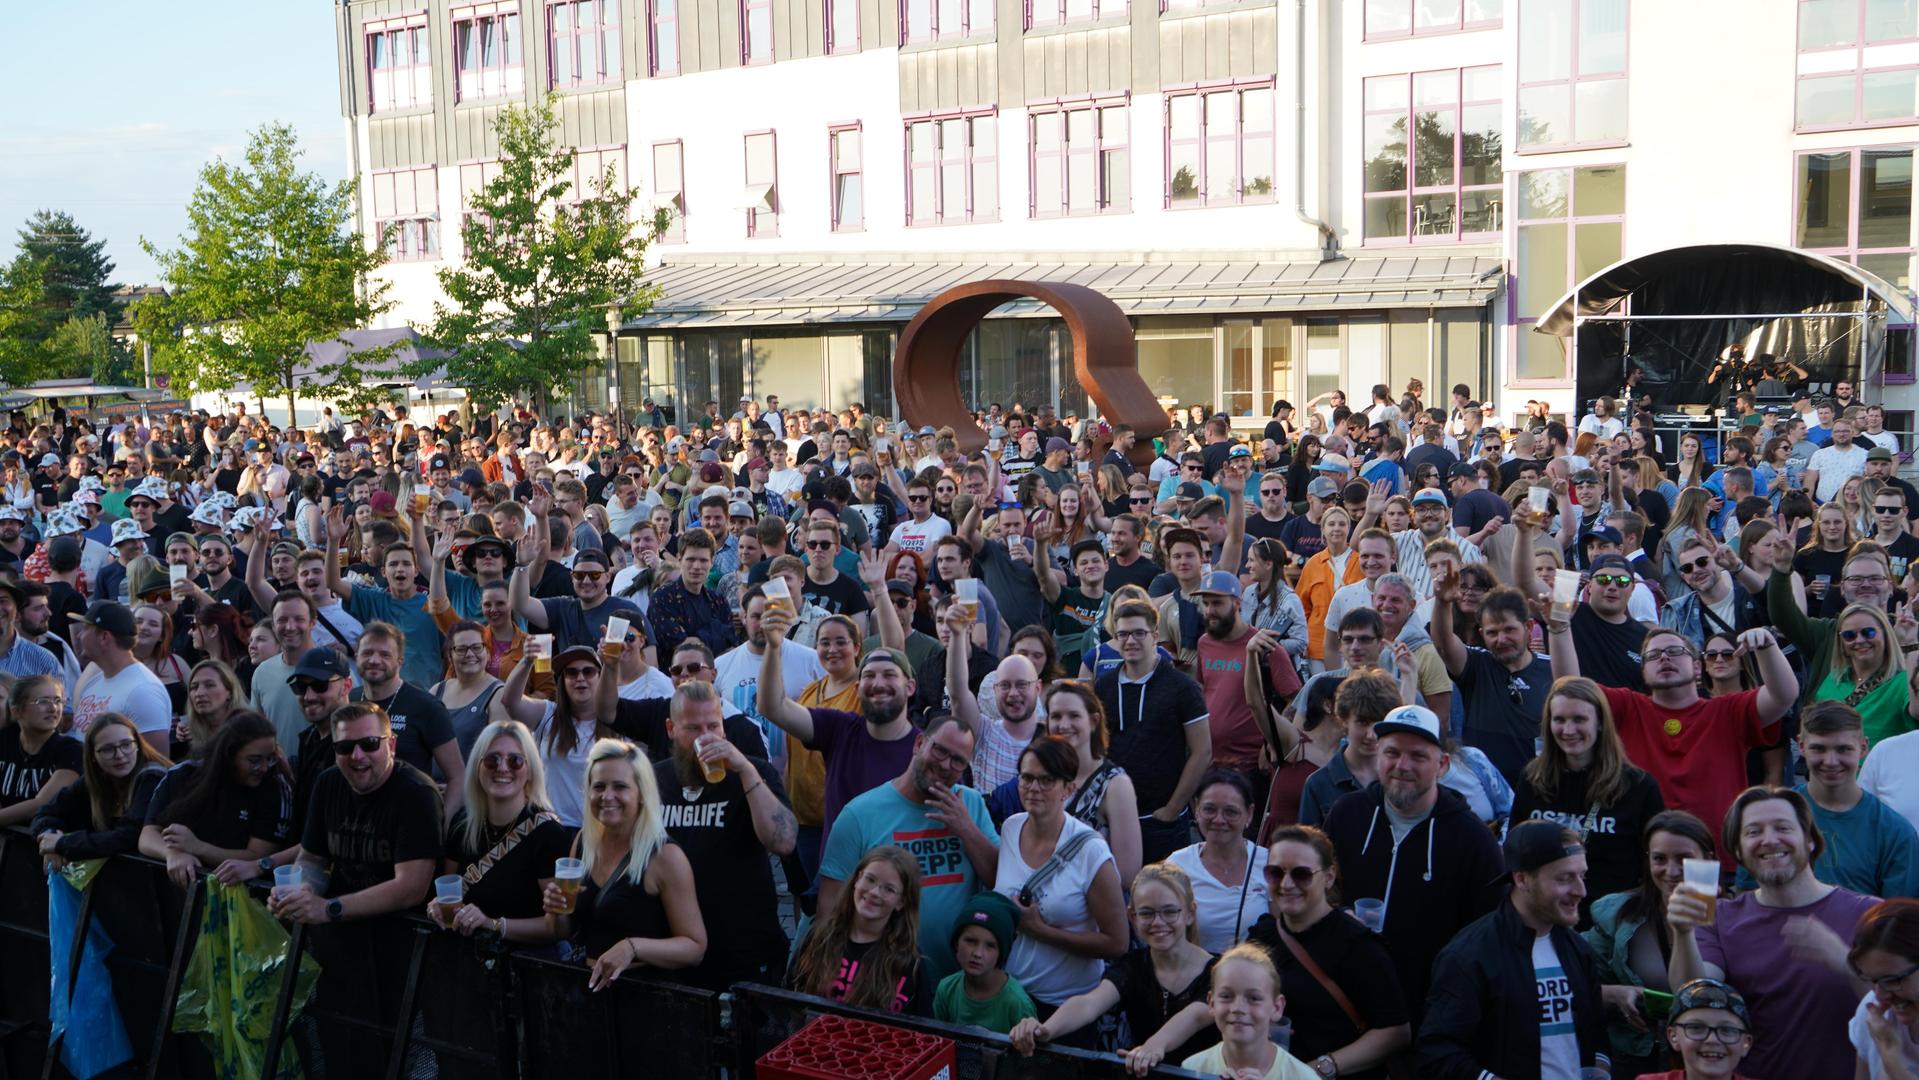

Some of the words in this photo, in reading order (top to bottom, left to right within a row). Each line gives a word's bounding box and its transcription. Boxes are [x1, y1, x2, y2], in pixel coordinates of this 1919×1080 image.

[917, 853, 962, 875] EPP
[1536, 978, 1572, 998] ORD
[1537, 997, 1576, 1022] EP
